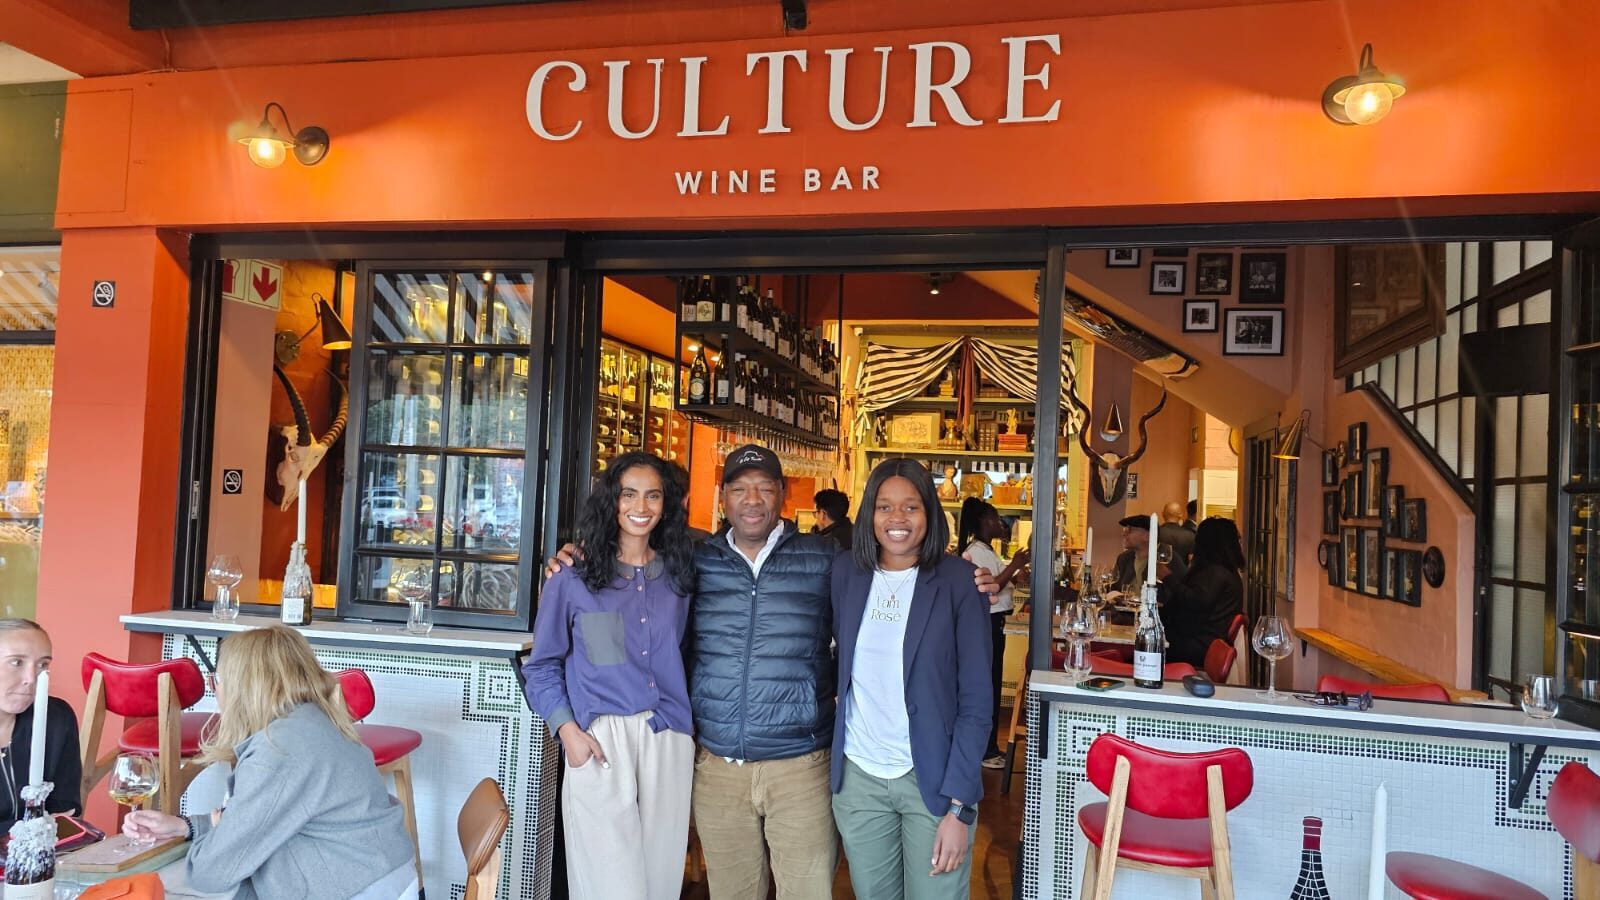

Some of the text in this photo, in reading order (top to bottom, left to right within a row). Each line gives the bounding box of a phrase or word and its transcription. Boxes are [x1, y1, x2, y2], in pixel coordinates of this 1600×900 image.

[526, 34, 1062, 140] CULTURE
[674, 166, 880, 195] WINE BAR
[881, 599, 900, 608] am
